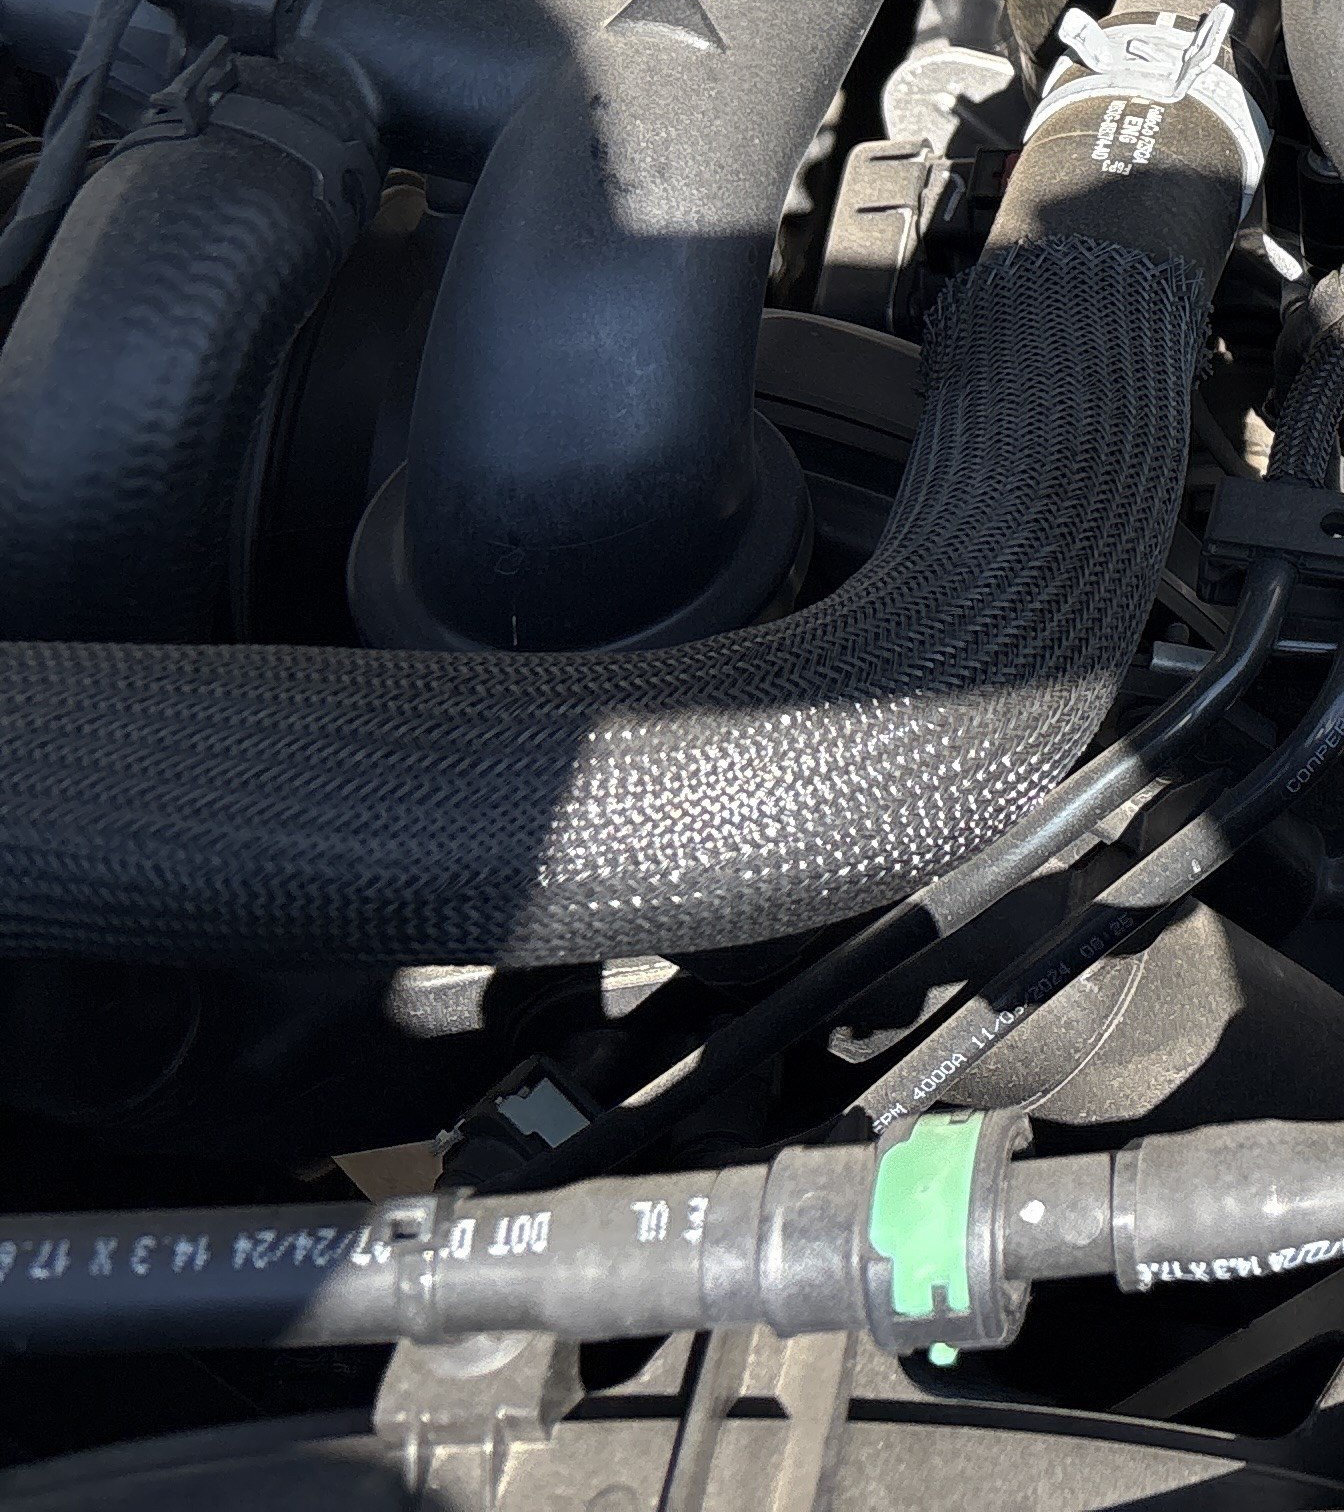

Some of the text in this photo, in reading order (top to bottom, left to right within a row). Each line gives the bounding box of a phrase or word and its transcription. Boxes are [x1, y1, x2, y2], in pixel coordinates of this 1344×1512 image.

[1118, 115, 1145, 144] ENG
[911, 1051, 969, 1101] 4000A
[487, 1211, 552, 1257] DOT
[87, 1234, 120, 1278] X
[130, 1235, 211, 1276] 14.3
[1211, 1255, 1262, 1280] 14.3
